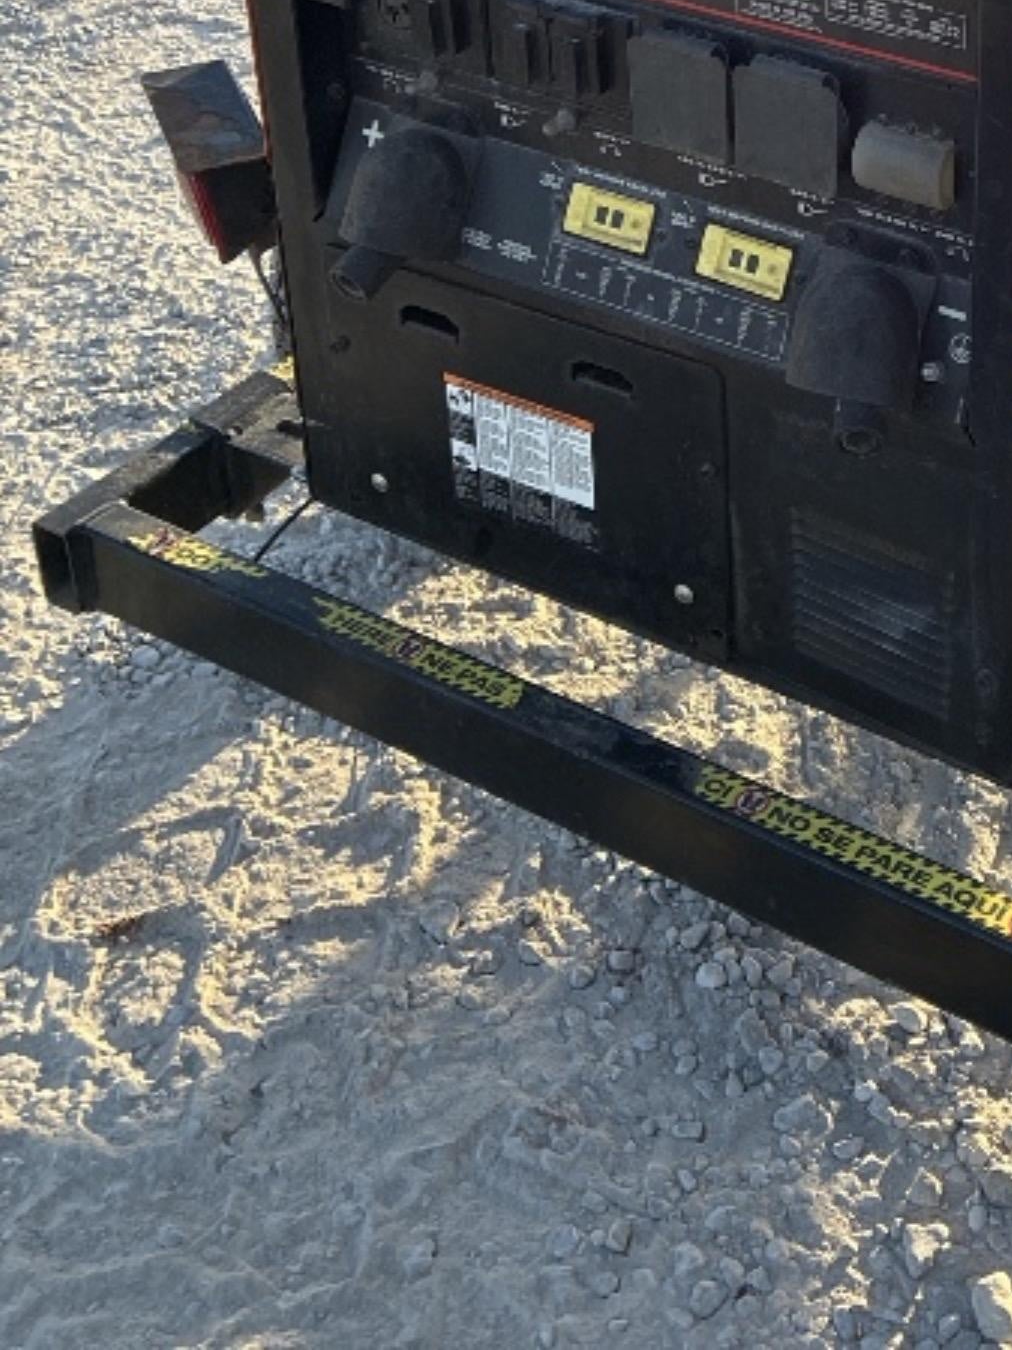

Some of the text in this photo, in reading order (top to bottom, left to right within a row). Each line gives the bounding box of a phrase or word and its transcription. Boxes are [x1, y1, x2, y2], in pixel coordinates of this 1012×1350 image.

[768, 805, 811, 833] NO
[814, 827, 855, 851] SE
[855, 845, 934, 886] PARE
